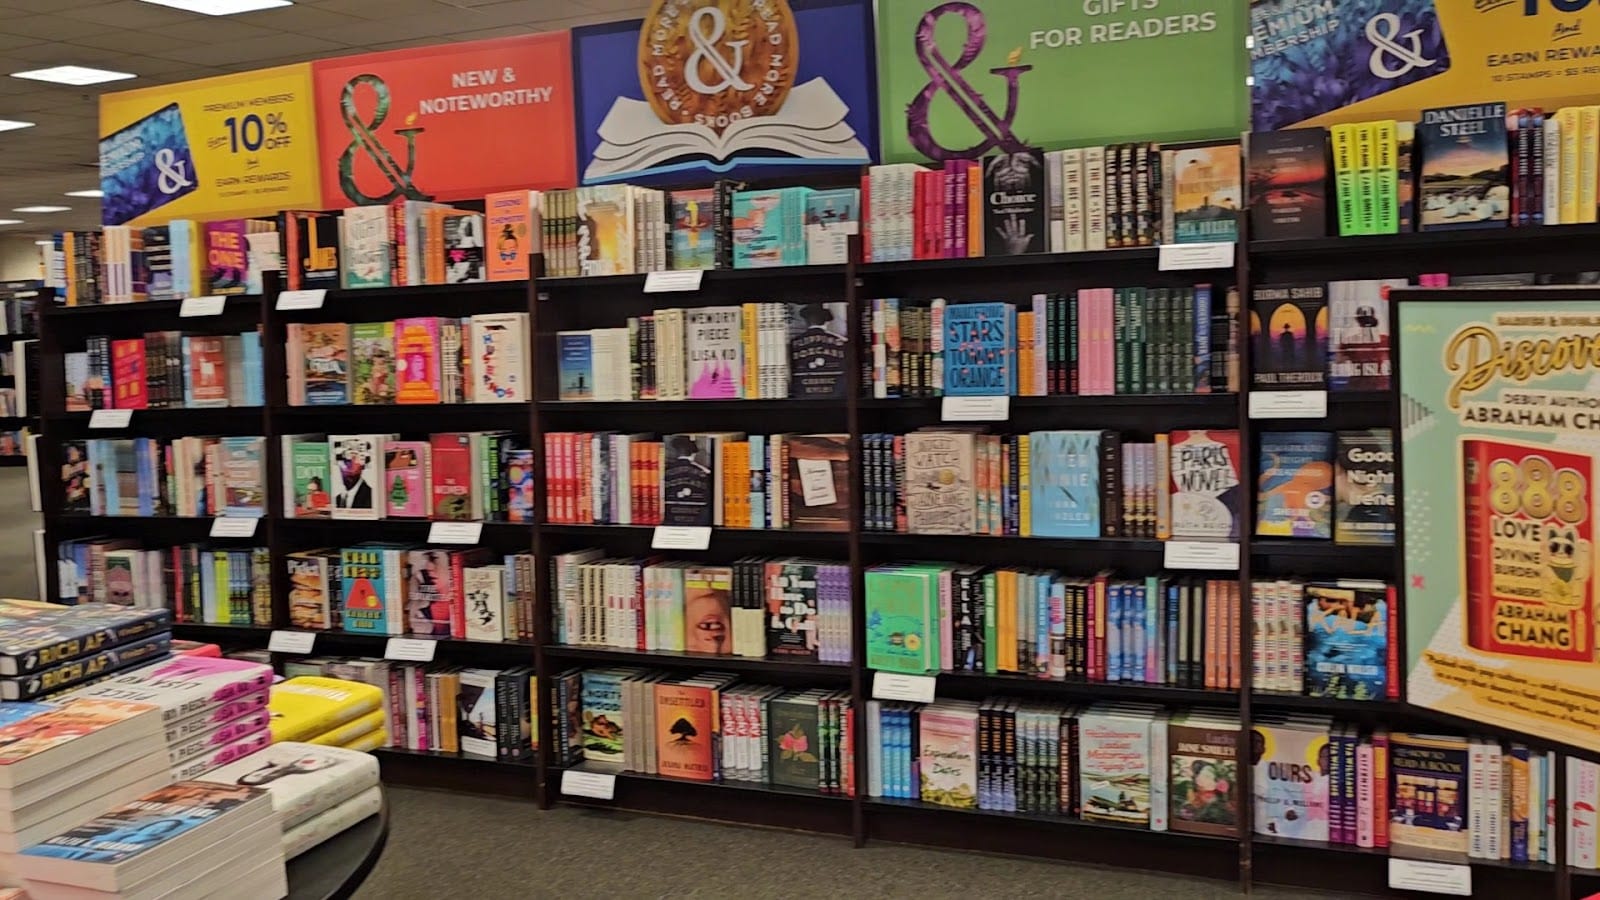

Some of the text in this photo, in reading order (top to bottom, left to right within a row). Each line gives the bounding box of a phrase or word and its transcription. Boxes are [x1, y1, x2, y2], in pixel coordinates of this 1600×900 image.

[1030, 12, 1217, 49] FOR READERS
[1365, 12, 1436, 79] &
[1487, 52, 1539, 67] EARN
[452, 67, 516, 88] NEW &
[419, 86, 553, 115] NOTEWORTHY
[1425, 104, 1504, 125] DANIELLE
[224, 112, 288, 153] 10 %
[1440, 120, 1488, 137] STEEL
[264, 135, 292, 150] OFF
[155, 148, 192, 194] &
[208, 231, 241, 250] THE
[208, 250, 246, 270] ONE
[697, 328, 731, 341] PIECE
[949, 320, 1005, 343] STARS
[691, 349, 737, 362] LISA KO
[1504, 394, 1546, 405] DEBUT
[1464, 407, 1567, 429] ABRAHAM
[1180, 445, 1228, 469] PARIS
[1181, 468, 1231, 492] NOVEL
[1490, 455, 1587, 524] 888
[1493, 519, 1541, 542] LOVE
[1495, 547, 1541, 565] DIVINE
[1494, 564, 1541, 579] BURDEN
[1496, 584, 1542, 598] NUMBERS
[1497, 604, 1568, 625] ABRAHAM
[1496, 622, 1570, 647] CHANG
[39, 633, 107, 665] RICH AF
[42, 655, 108, 688] RICH AF
[1268, 761, 1313, 785] OURS
